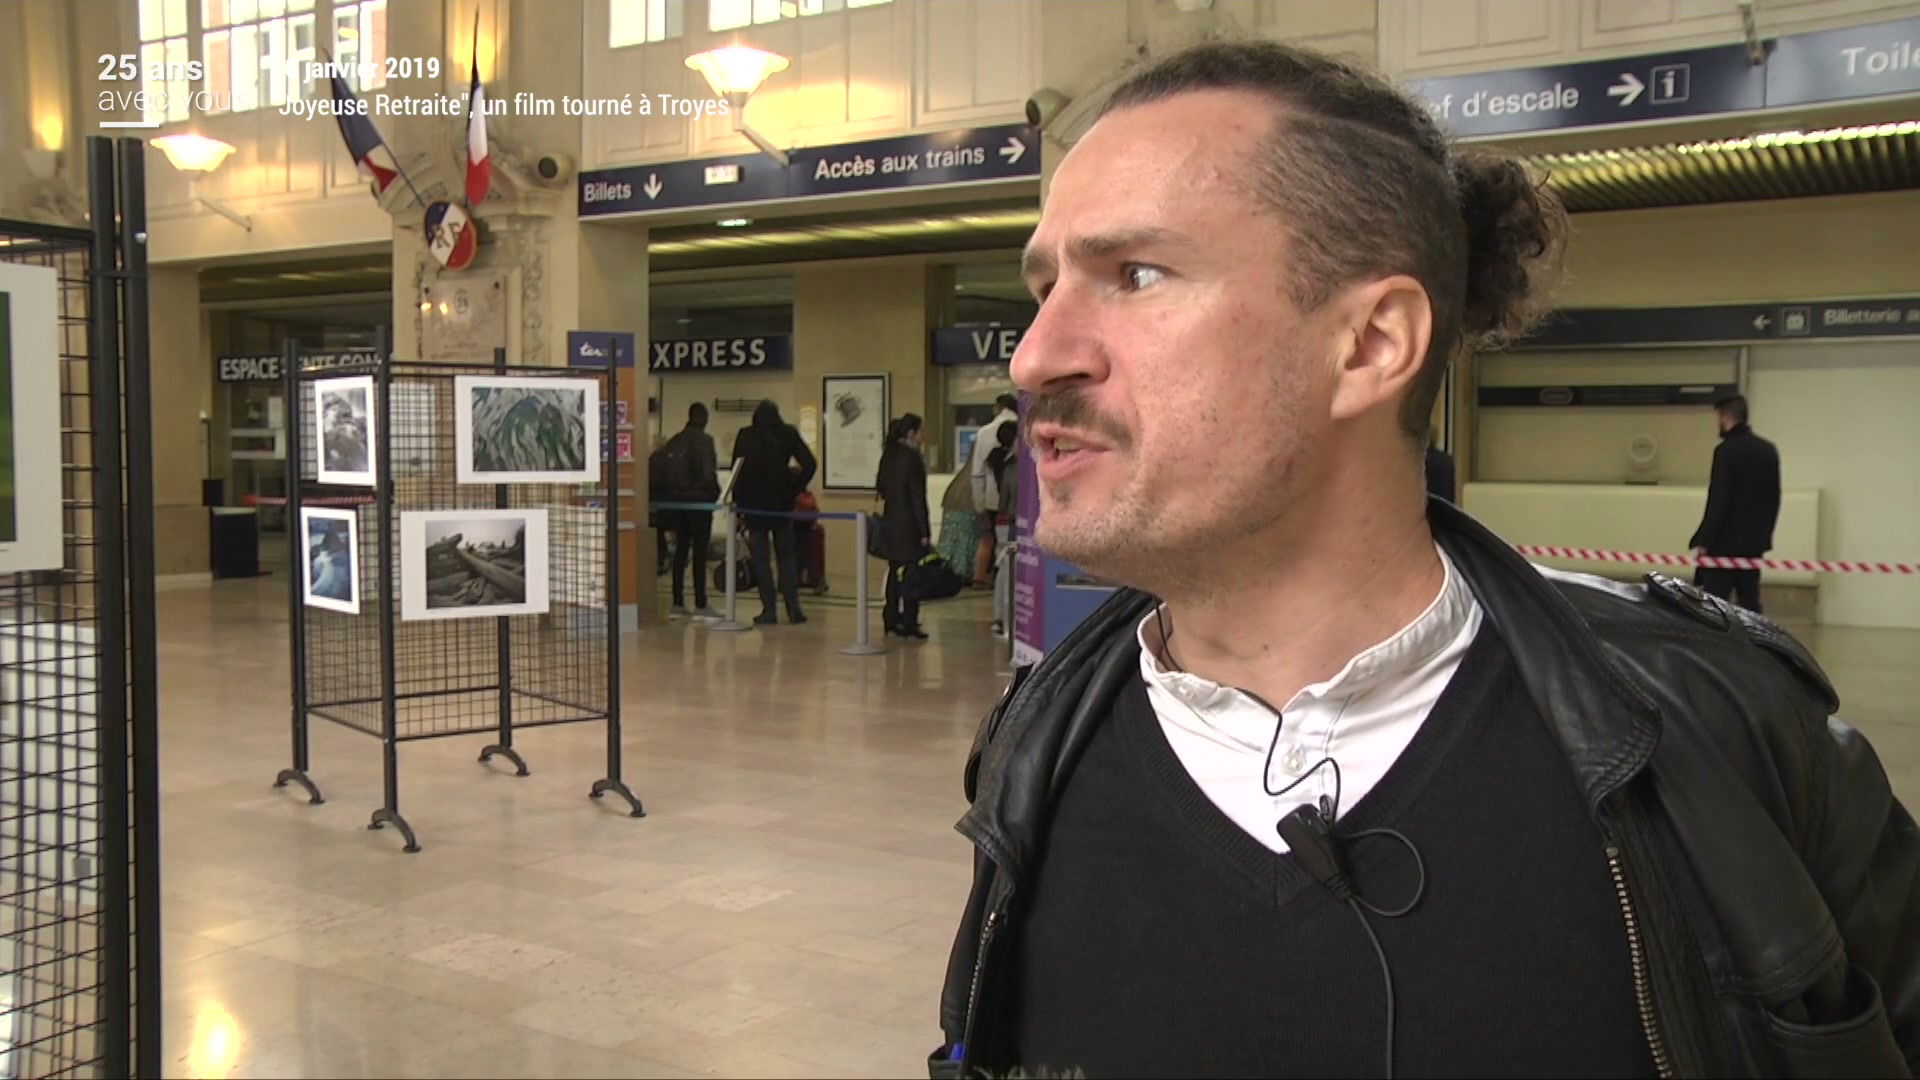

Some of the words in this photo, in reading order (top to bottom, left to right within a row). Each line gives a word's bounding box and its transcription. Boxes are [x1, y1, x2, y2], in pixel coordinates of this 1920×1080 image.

[1462, 81, 1580, 118] d'escale
[814, 155, 876, 181] Accès
[881, 153, 919, 175] aux
[925, 146, 985, 170] trains
[583, 182, 632, 203] Billets
[651, 338, 767, 369] XPRESS
[971, 329, 1018, 361] VE
[219, 357, 280, 381] ESPACE
